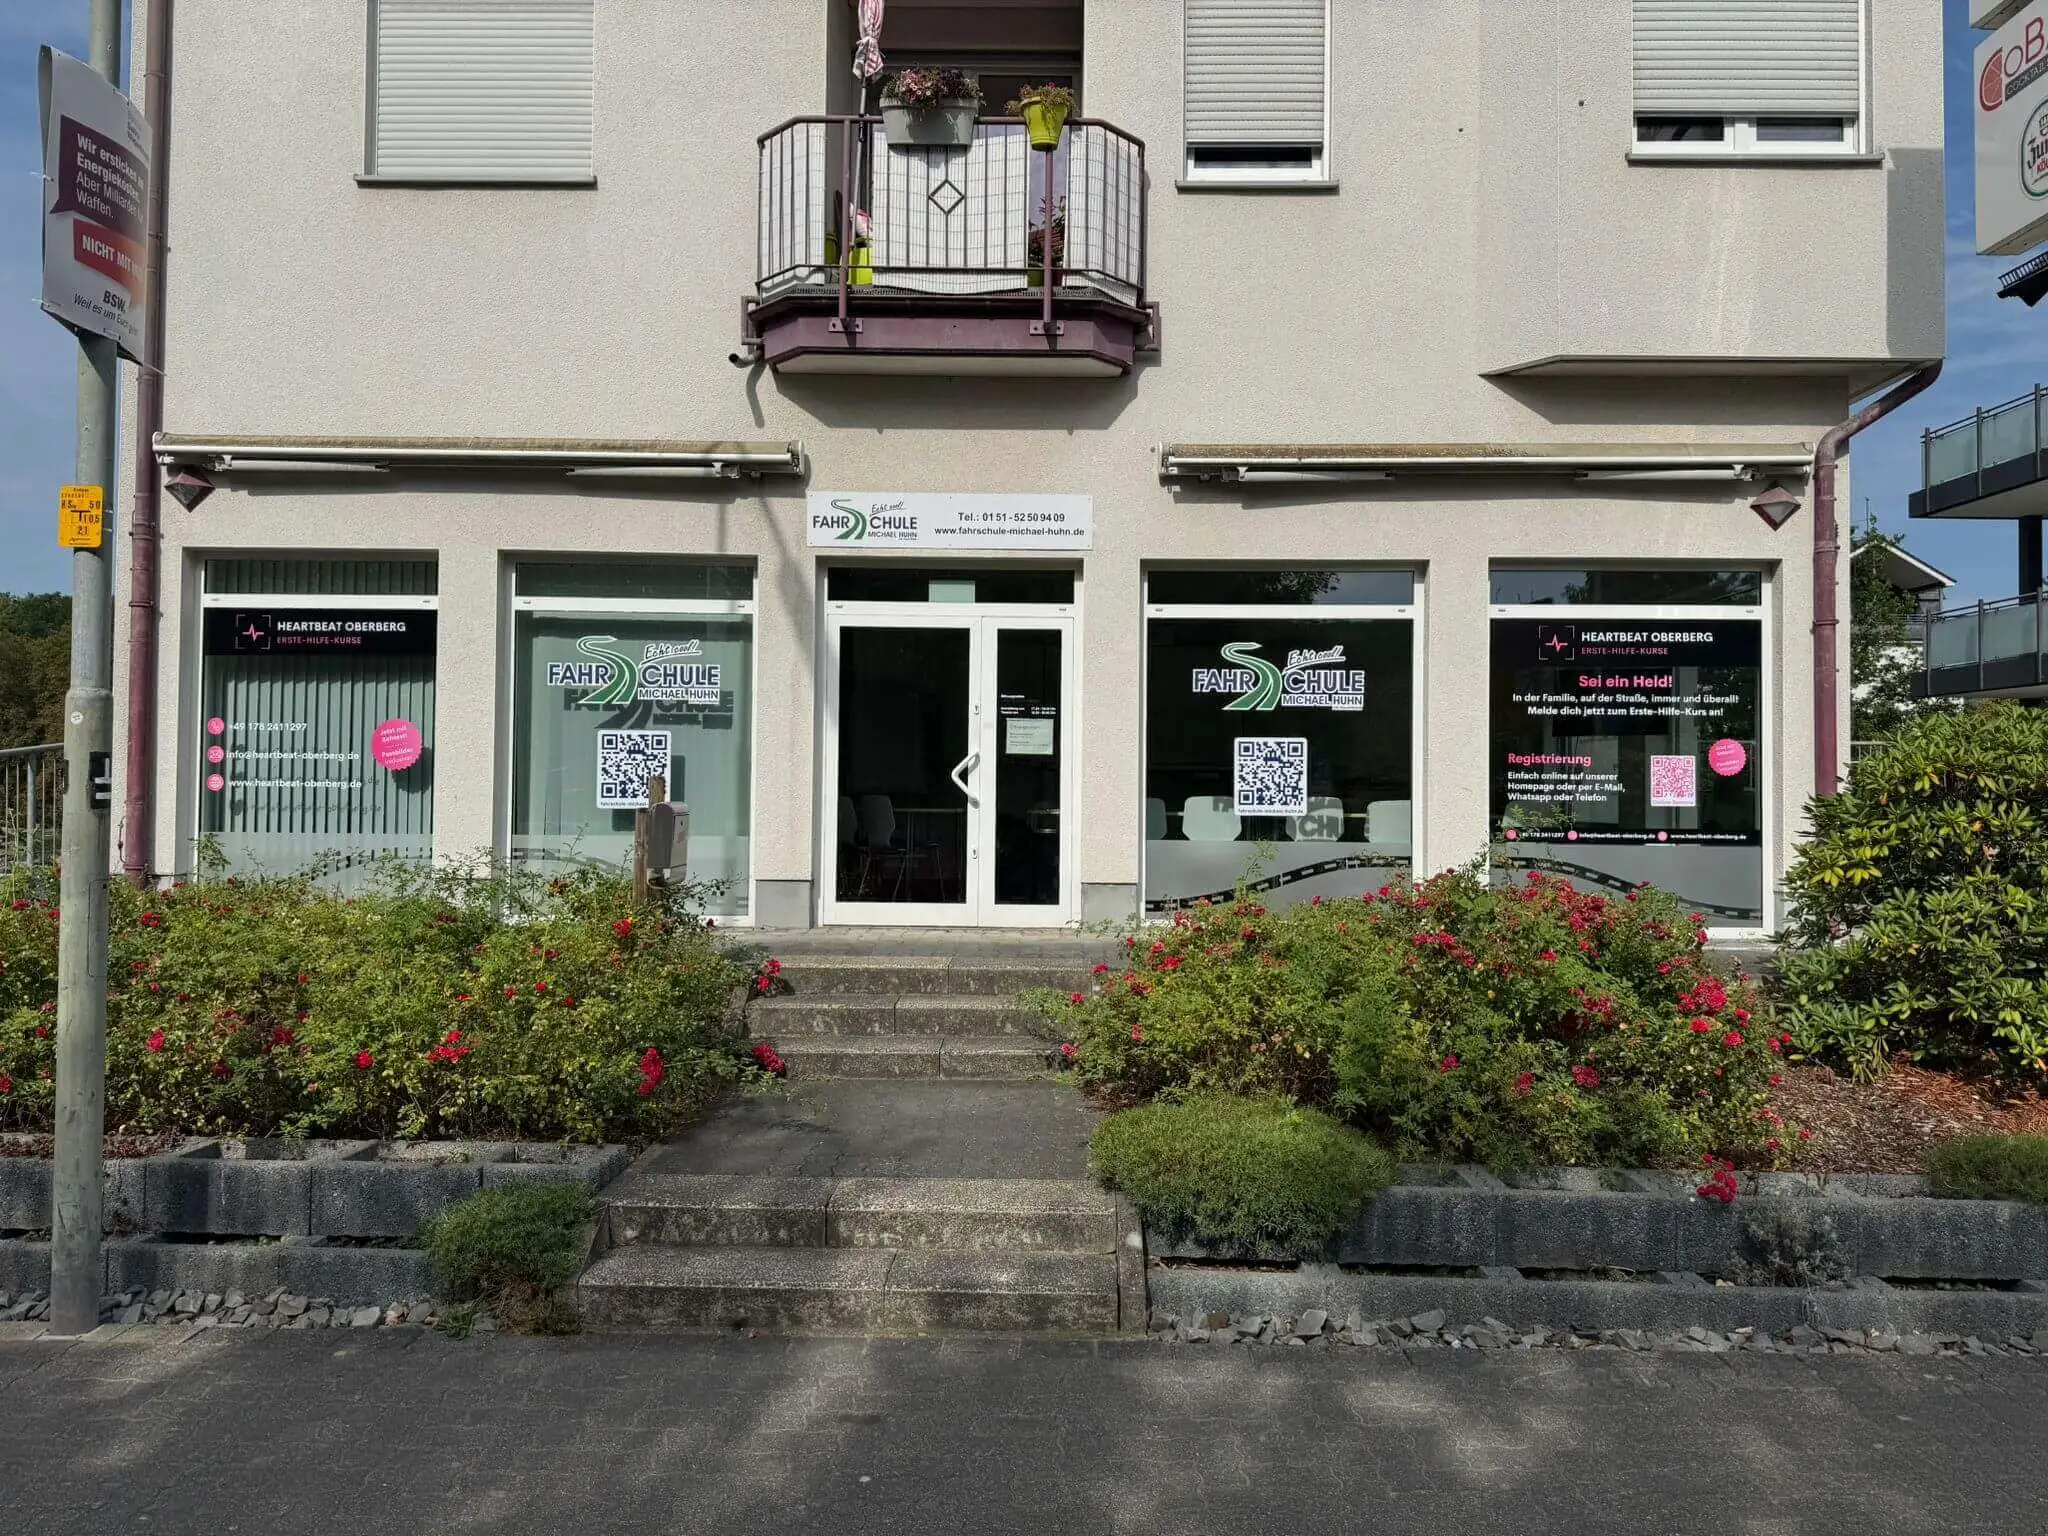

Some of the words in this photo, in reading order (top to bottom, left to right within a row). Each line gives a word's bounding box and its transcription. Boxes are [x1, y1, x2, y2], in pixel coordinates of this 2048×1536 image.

[77, 133, 97, 154] Wir
[76, 171, 101, 192] Aber
[76, 188, 114, 218] Waffen.
[82, 234, 115, 262] NICHT
[73, 292, 92, 310] Weil
[92, 303, 102, 315] es
[104, 309, 116, 322] um
[958, 512, 979, 522] Tel.:
[934, 526, 1085, 537] www.fahrschule-michael-huhn.de
[277, 621, 342, 632] HEARTBEAT
[345, 621, 406, 632] OBERBERG
[277, 636, 362, 645] ERSTE-HILFE-KURSE
[1581, 632, 1648, 642] HEARTBEAT
[1651, 632, 1713, 642] OBERBERG
[1581, 647, 1669, 655] ERSTE-HILFE-KURSE
[1578, 675, 1602, 688] Sei
[1606, 675, 1629, 688] ein
[1633, 675, 1673, 688] Held!
[638, 688, 686, 699] MICHAEL
[689, 688, 718, 699] HUHN
[1512, 692, 1522, 702] In
[1524, 692, 1541, 702] der
[1542, 692, 1578, 704] Familie,
[1580, 693, 1596, 702] auf
[1597, 693, 1614, 702] der
[1616, 693, 1649, 704] Straße,
[1651, 693, 1681, 703] immer
[1683, 694, 1701, 703] und
[1703, 694, 1739, 704] überall!
[1282, 694, 1329, 705] MICHAEL
[1333, 694, 1363, 705] HUHN
[1528, 706, 1558, 715] Melde
[1560, 706, 1581, 715] dich
[1583, 706, 1605, 717] jetzt
[1607, 708, 1627, 716] zum
[1630, 706, 1707, 717] Erste-Hilfe-Kurs
[1708, 707, 1724, 717] an!
[226, 750, 360, 762] info@heartbeat-oberberg.de
[1508, 753, 1592, 767] Registrierung
[1507, 771, 1540, 780] Einfach
[1541, 771, 1568, 780] online
[1570, 772, 1584, 780] auf
[228, 779, 362, 790] www.heartbeat-oberberg.de
[1507, 782, 1554, 792] Homepage
[1556, 782, 1577, 791] oder
[1578, 784, 1593, 792] per
[1595, 783, 1626, 793] E-Mail,
[1507, 792, 1552, 803] Whatsapp
[1553, 793, 1574, 802] oder
[1575, 793, 1607, 802] Telefon
